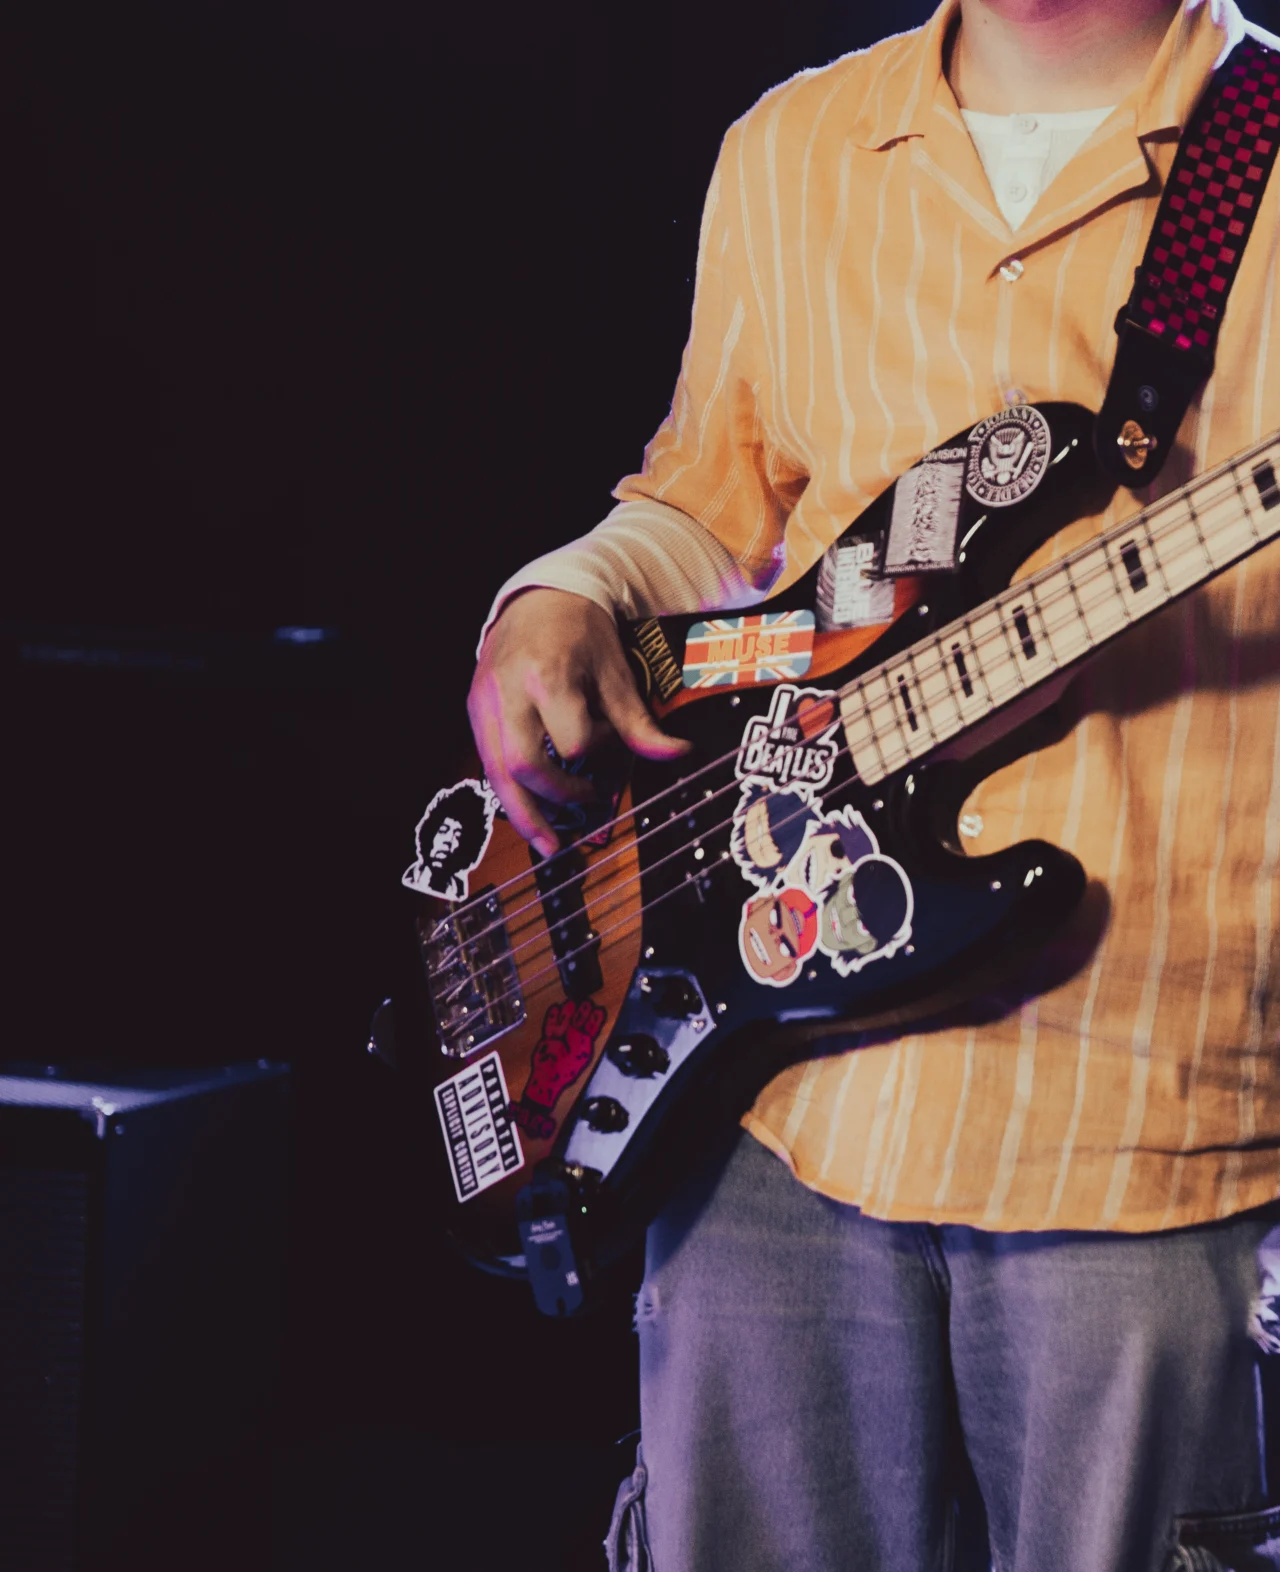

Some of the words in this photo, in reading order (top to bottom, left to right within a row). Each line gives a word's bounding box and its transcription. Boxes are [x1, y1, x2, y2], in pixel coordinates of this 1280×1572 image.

[634, 616, 683, 700] NIRVANA
[707, 633, 791, 664] MUSE
[743, 725, 829, 783] BEATLES
[441, 1087, 464, 1140] EXPLICIT
[454, 1140, 475, 1191] CONTENT
[458, 1072, 501, 1179] ADVISORY
[482, 1063, 516, 1166] PARENTAL
